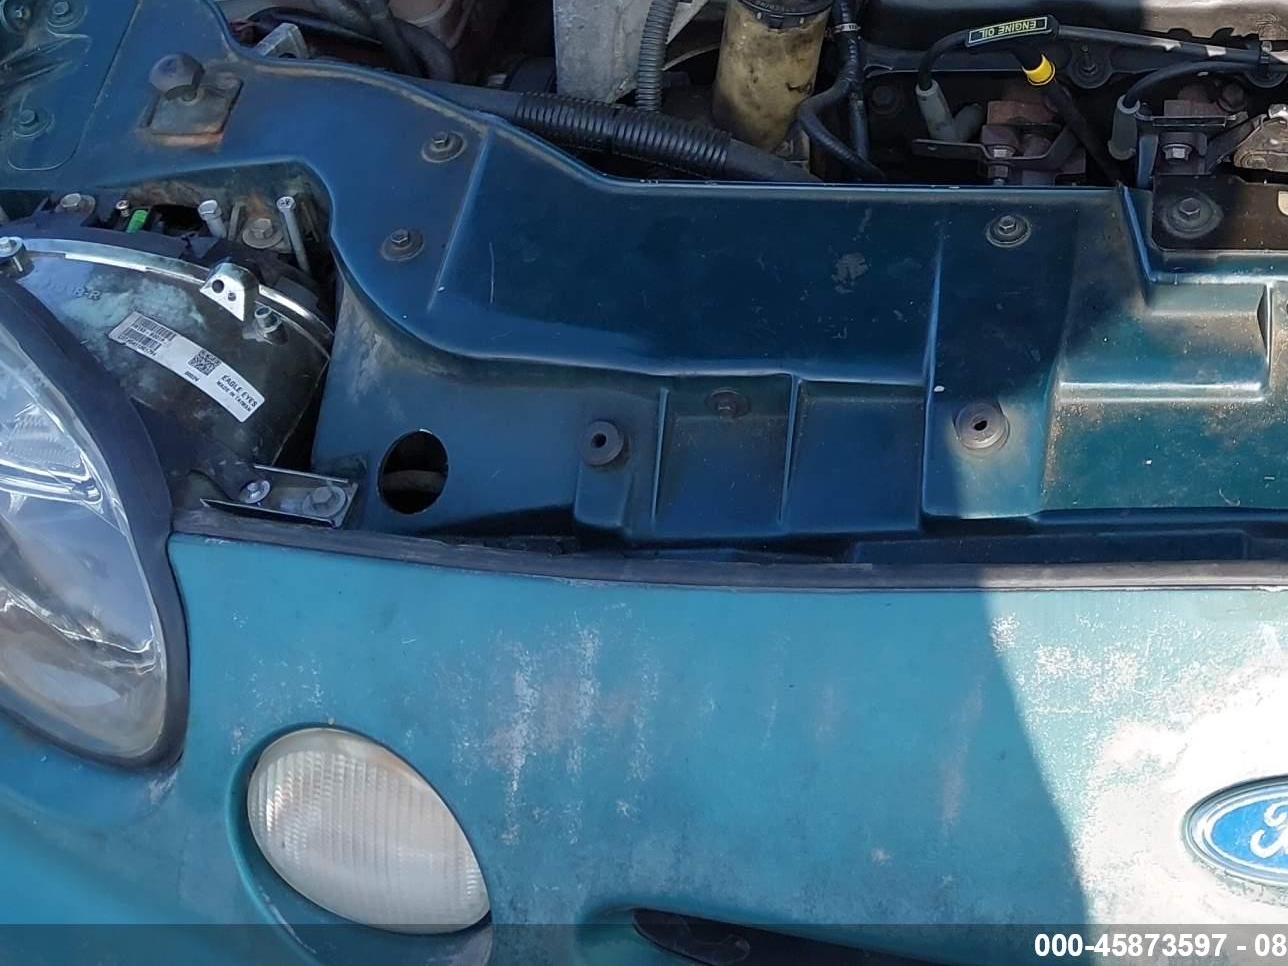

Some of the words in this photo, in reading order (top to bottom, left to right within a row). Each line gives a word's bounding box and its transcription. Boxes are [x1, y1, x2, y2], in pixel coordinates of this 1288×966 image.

[980, 28, 995, 38] OIL
[998, 19, 1037, 35] ENGINE
[222, 375, 243, 393] EAGLE
[241, 391, 258, 407] EYES
